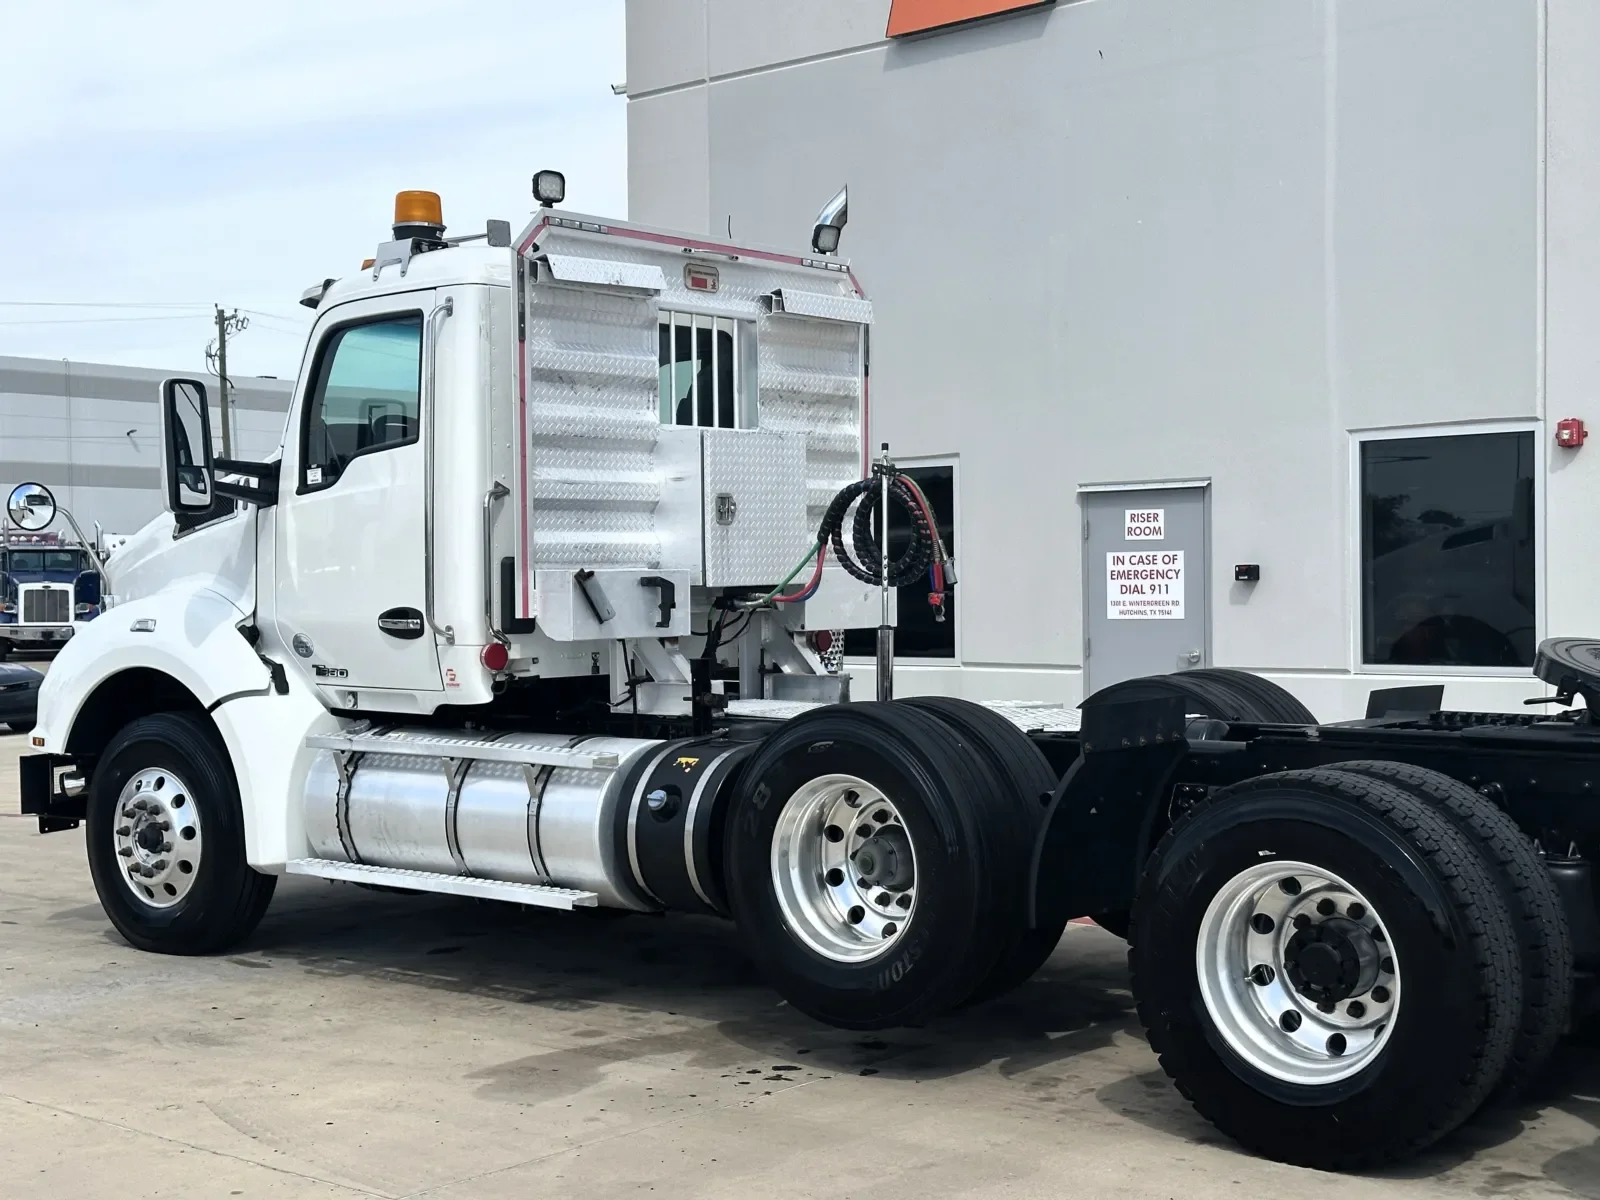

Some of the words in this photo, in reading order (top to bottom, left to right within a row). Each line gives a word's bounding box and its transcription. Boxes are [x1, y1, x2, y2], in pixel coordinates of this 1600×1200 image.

[1130, 512, 1159, 523] RISER
[1127, 526, 1162, 537] ROOM
[1112, 555, 1125, 566] IN
[1128, 554, 1158, 566] CASE
[1161, 554, 1178, 565] OF
[1110, 568, 1181, 581] EMERGENCY
[1120, 583, 1146, 595] DIAL
[1149, 583, 1169, 595] 911
